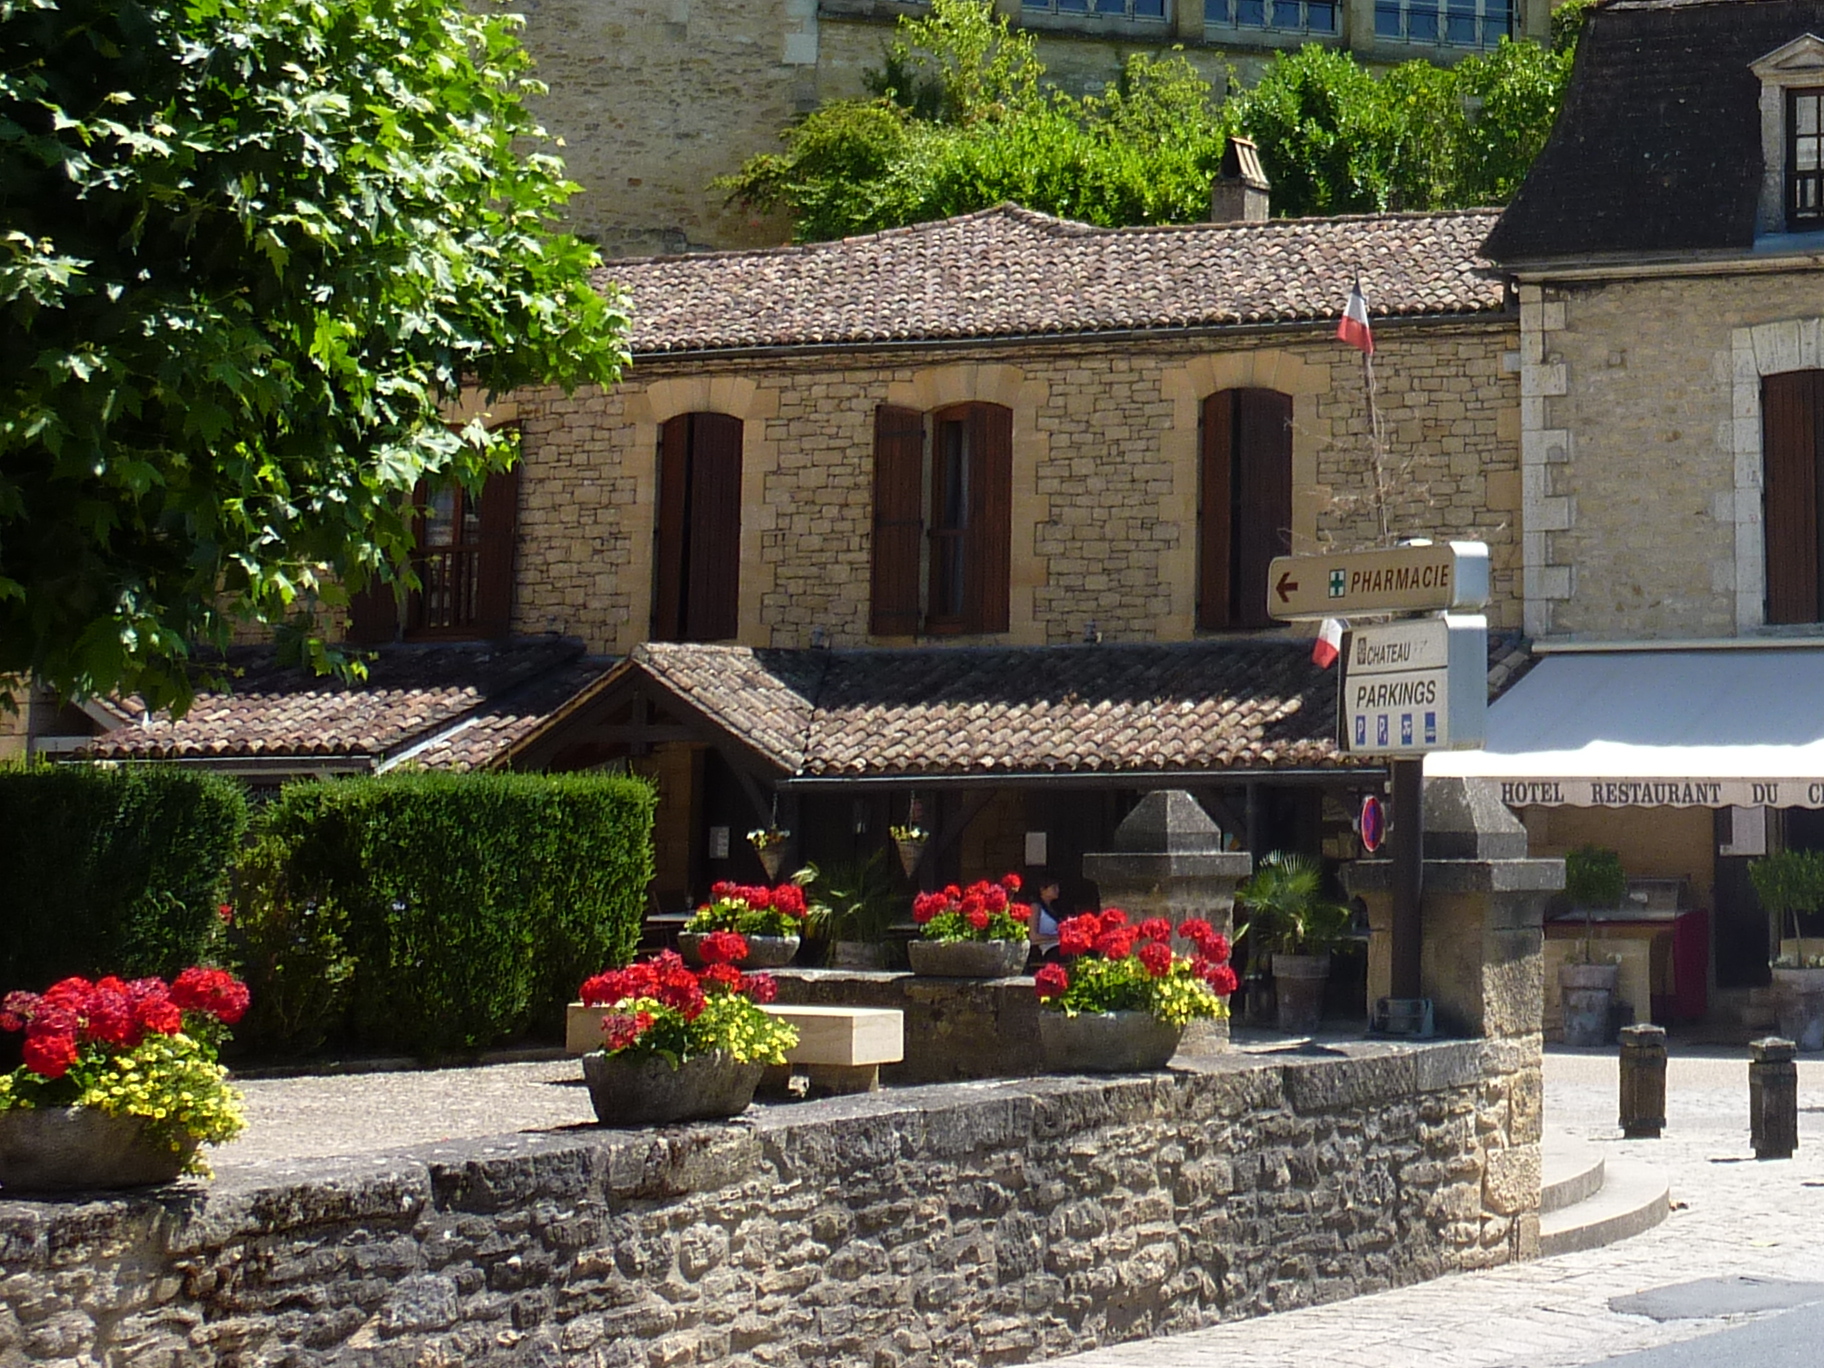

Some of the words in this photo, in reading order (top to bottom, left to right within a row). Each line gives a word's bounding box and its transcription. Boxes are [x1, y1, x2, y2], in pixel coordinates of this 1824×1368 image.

[1350, 564, 1450, 594] PHARMACIE
[1366, 642, 1411, 666] CHATEAU
[1356, 680, 1438, 709] PARKINGS
[1500, 782, 1565, 803] HOTEL
[1591, 782, 1722, 804] RESTAURANT
[1752, 783, 1779, 804] DU
